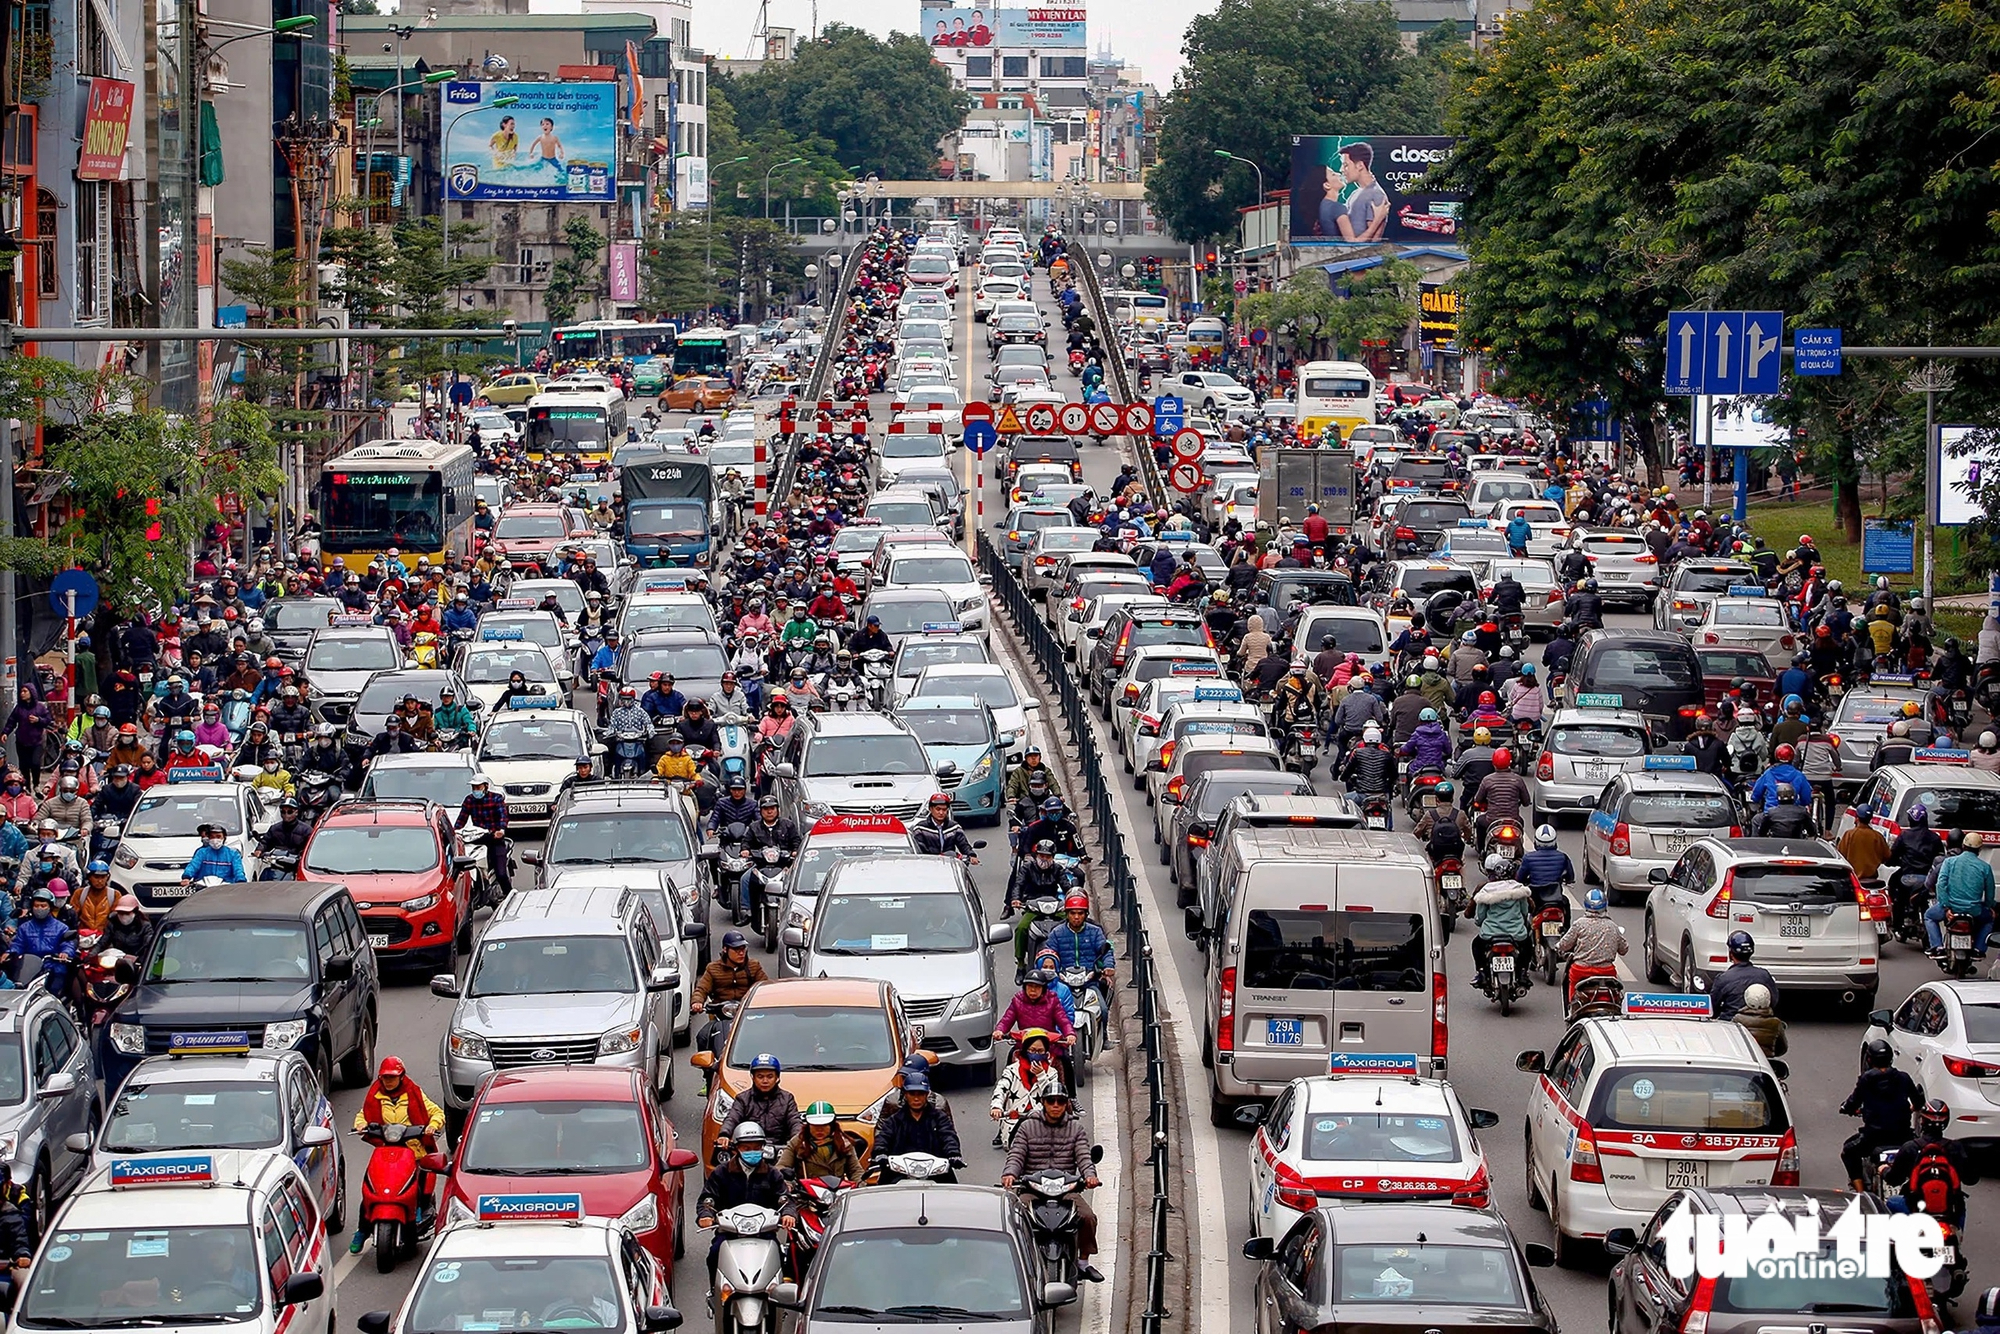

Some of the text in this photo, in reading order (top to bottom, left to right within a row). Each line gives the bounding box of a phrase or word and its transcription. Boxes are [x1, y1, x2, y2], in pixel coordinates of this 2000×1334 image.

[450, 87, 477, 99] Friso
[1385, 171, 1407, 182] CỰC
[1822, 336, 1833, 344] XE
[1807, 349, 1827, 358] TRỌNG
[651, 468, 682, 480] Xe24h
[1198, 689, 1238, 698] 38.222.888
[837, 817, 871, 829] Alpha
[1787, 916, 1803, 925] 30A
[1251, 994, 1288, 1002] TRANSIT
[1638, 999, 1706, 1008] TAXIGROUP
[1275, 1021, 1294, 1032] 29A
[1267, 1032, 1301, 1044] 011.76
[533, 1050, 554, 1060] Ford
[1342, 1060, 1413, 1068] TAXIGROUP
[1632, 1134, 1778, 1148] 3A 38.57.57.57
[124, 1164, 208, 1177] TAXIGROUP
[1677, 1161, 1698, 1173] 30A
[1391, 1181, 1438, 1190] 38.26.26.26
[493, 1202, 576, 1212] TAXIGROUP
